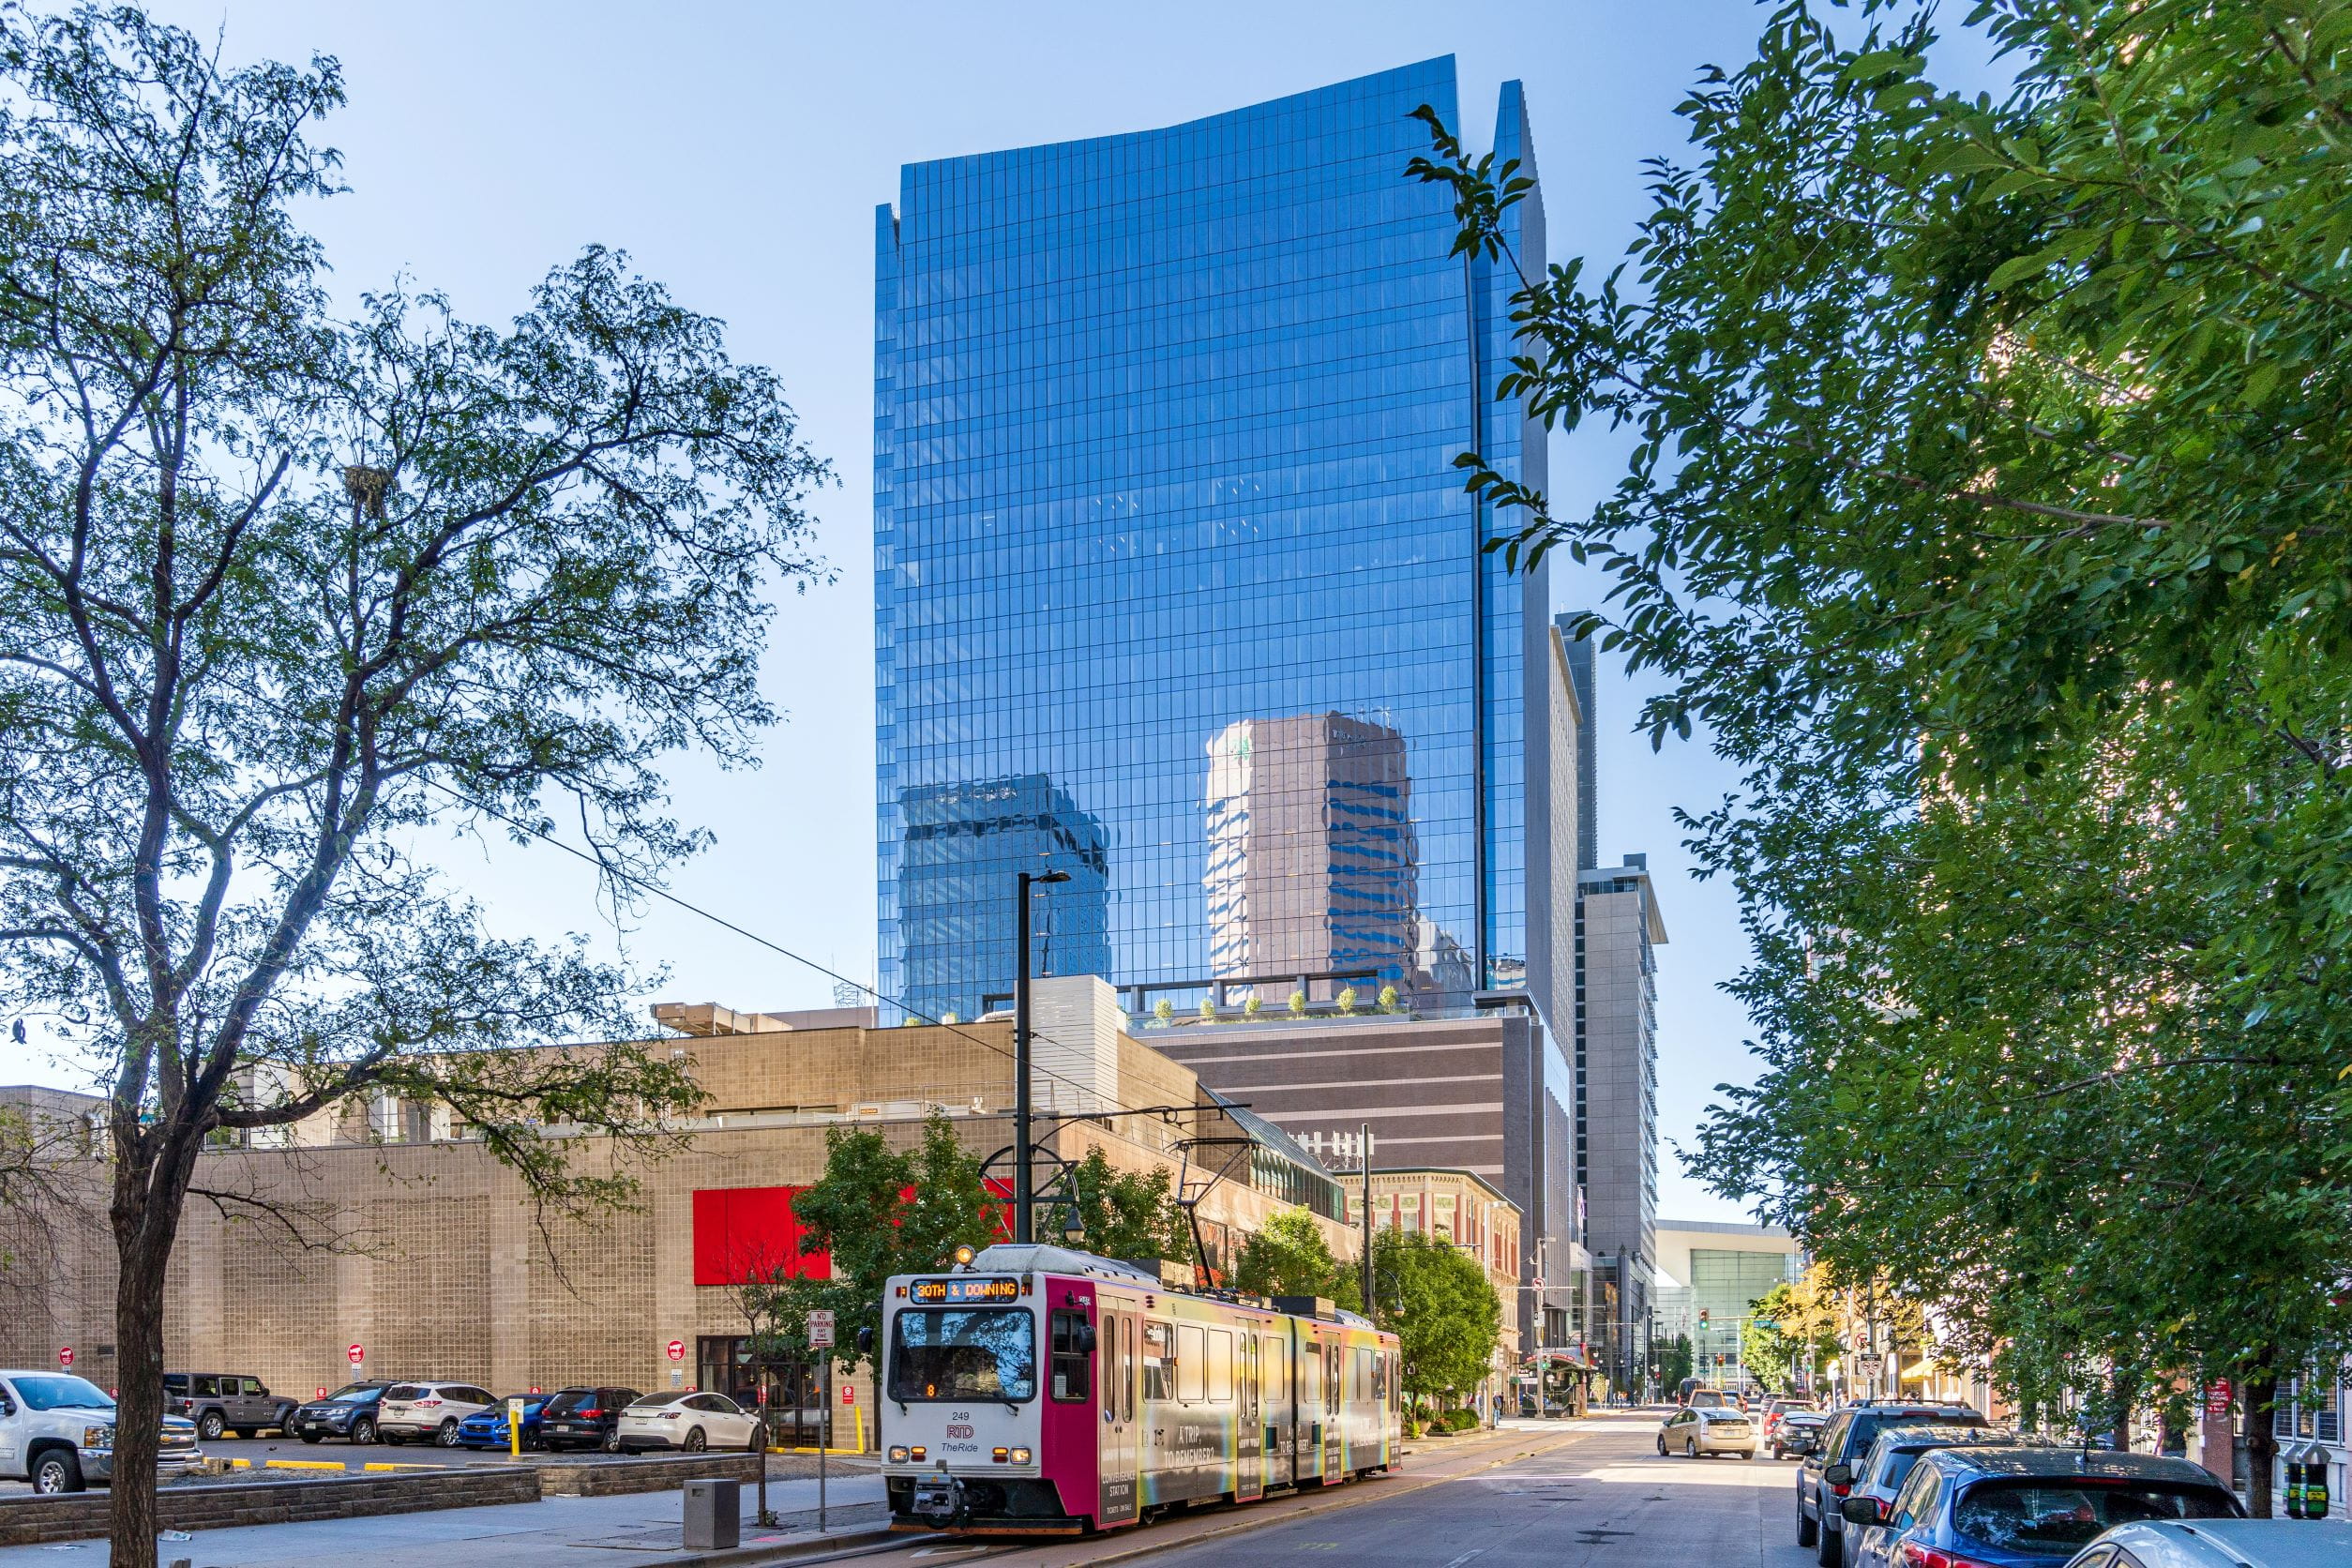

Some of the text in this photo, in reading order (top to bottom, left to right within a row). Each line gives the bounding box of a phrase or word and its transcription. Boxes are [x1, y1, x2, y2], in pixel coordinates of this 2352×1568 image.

[917, 1283, 1016, 1297] 30TH & DOWNING
[927, 1384, 935, 1396] 8
[952, 1411, 970, 1421] 249
[946, 1425, 974, 1440] RTD
[1178, 1425, 1201, 1445] A TRIP,
[1164, 1450, 1175, 1469] TO
[1175, 1446, 1214, 1468] REMEMBER?
[1102, 1470, 1136, 1485] CONVERGENCE
[1109, 1485, 1128, 1497] STATION
[1107, 1505, 1119, 1515] TICKETS
